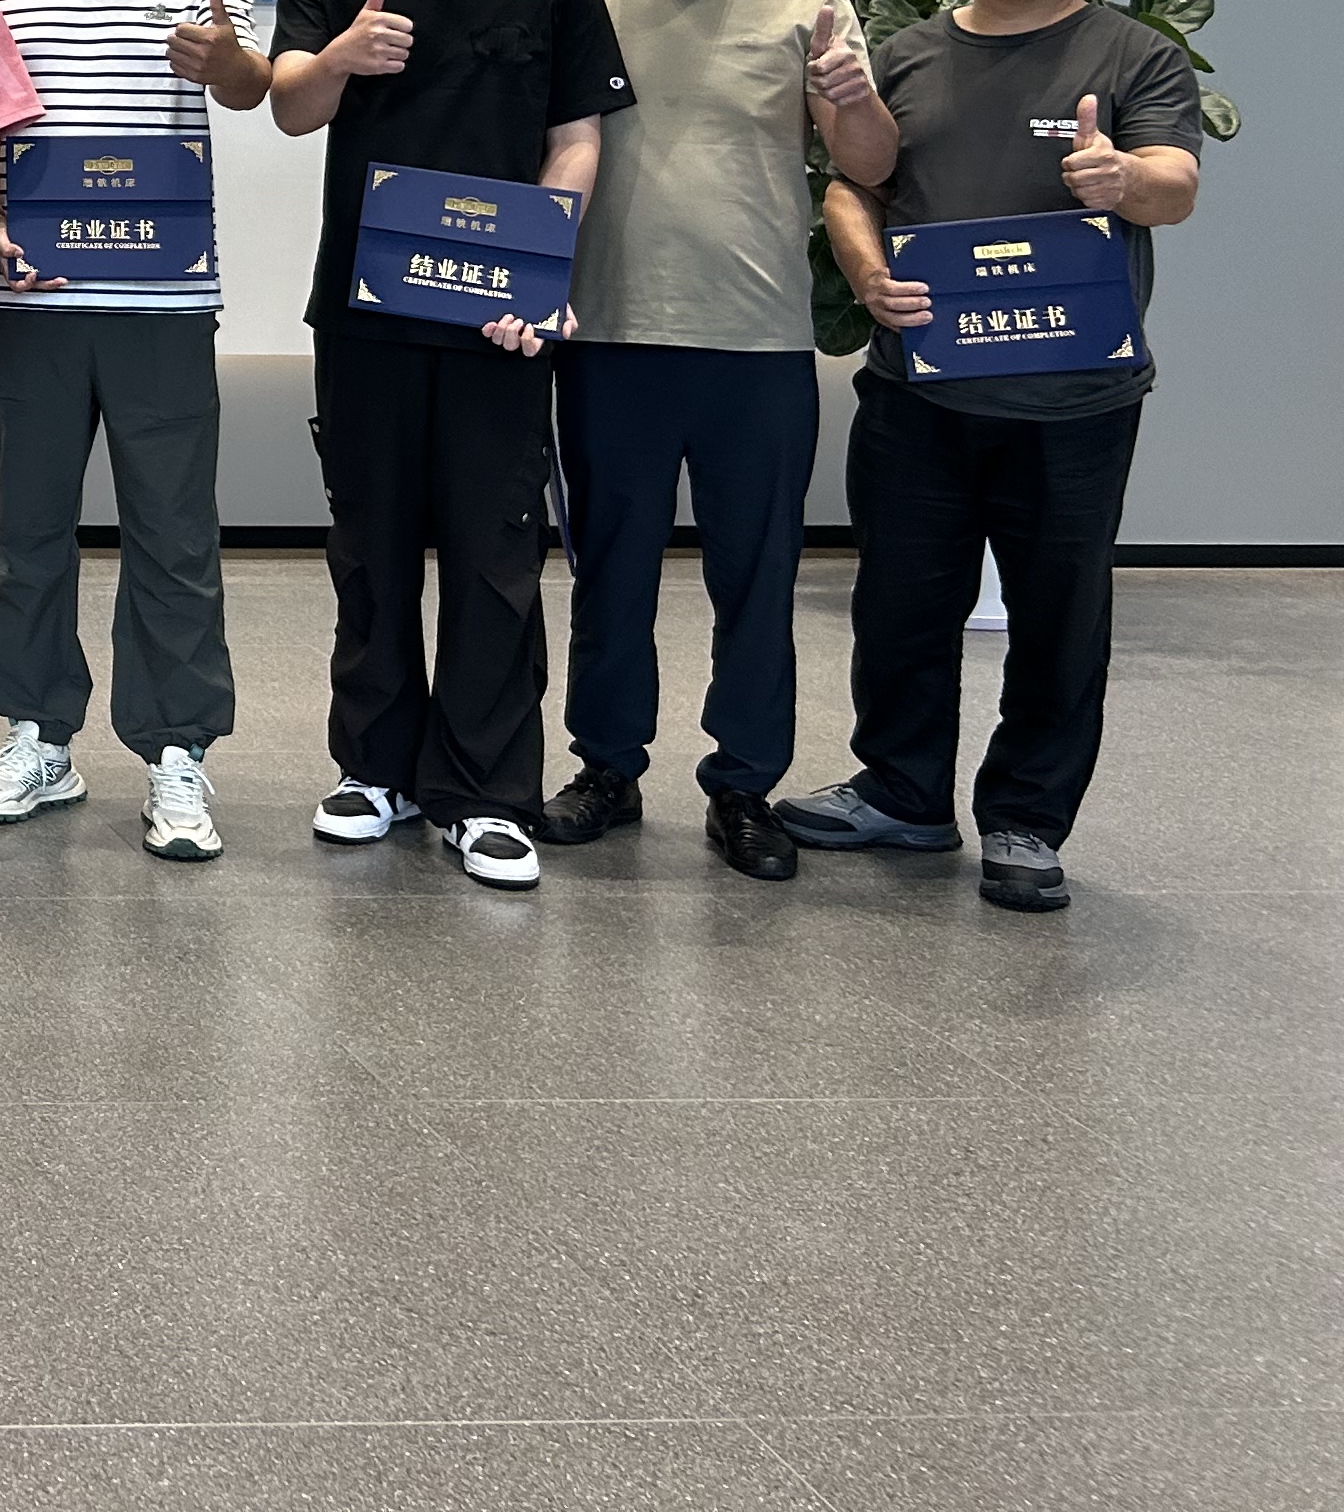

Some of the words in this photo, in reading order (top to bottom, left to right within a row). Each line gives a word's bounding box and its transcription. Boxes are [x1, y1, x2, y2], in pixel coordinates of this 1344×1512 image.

[60, 219, 154, 241] 结业证书
[409, 254, 510, 288] 结业证书
[958, 305, 1065, 335] 结业证书
